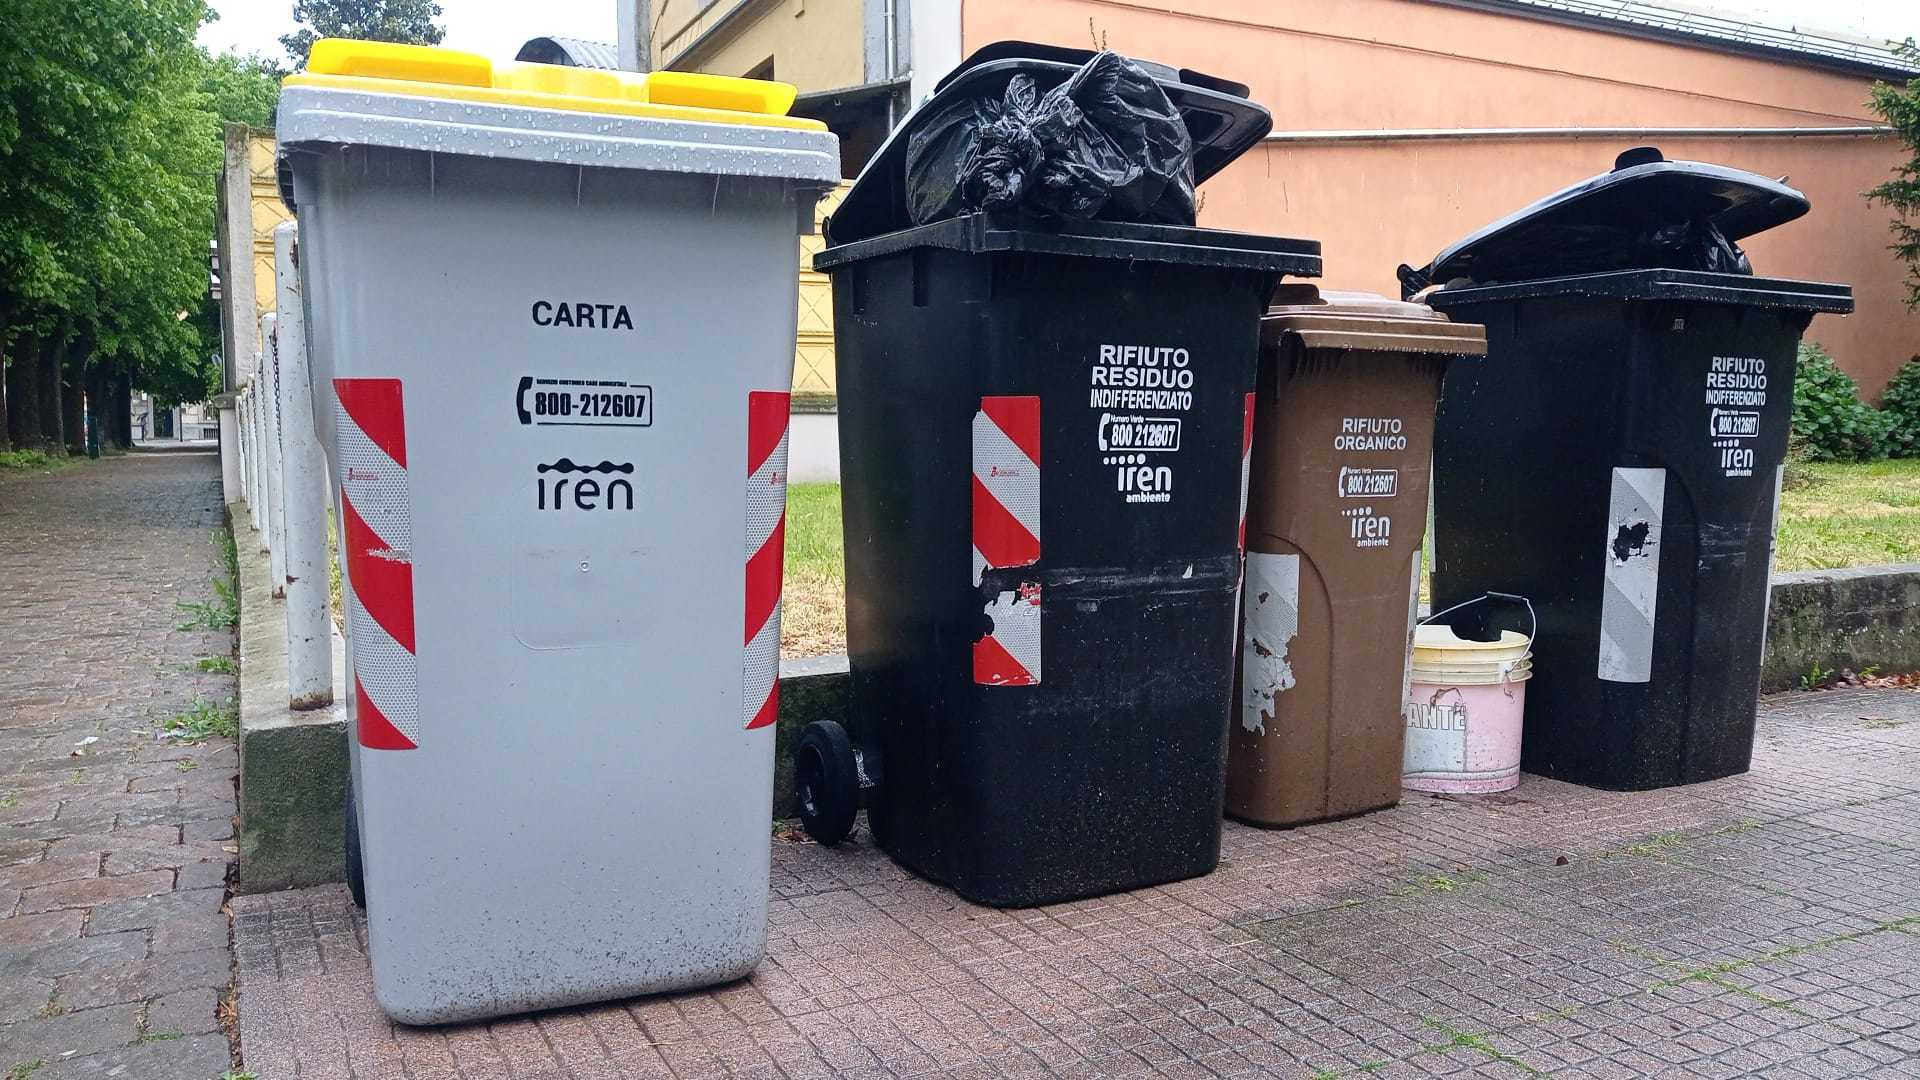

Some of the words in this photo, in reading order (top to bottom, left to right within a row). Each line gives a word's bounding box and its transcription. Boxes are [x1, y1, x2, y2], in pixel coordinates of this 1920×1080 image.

[532, 301, 634, 330] CARTA
[1100, 344, 1189, 368] RIFIUTO
[1712, 356, 1765, 374] RIFIUTO
[1091, 366, 1194, 389] RESIDUO
[1706, 372, 1767, 390] RESIDUO
[535, 392, 646, 418] 800-212607
[1090, 388, 1193, 411] INDIFFERENZIATO
[1705, 389, 1766, 406] INDIFFERENZIATO
[1111, 423, 1132, 446] 800
[1134, 424, 1176, 446] 212607
[1342, 418, 1402, 434] RIFIUTO
[1718, 416, 1732, 433] 800
[1732, 416, 1757, 434] 212607
[1334, 435, 1407, 450] ORGANICO
[1721, 448, 1754, 468] iren
[1117, 466, 1172, 491] iren
[1347, 475, 1363, 493] 800
[1365, 475, 1395, 493] 212607
[538, 479, 634, 510] iren
[1126, 491, 1171, 503] ambiente
[1351, 516, 1390, 538] iren
[1356, 538, 1389, 547] ambiente
